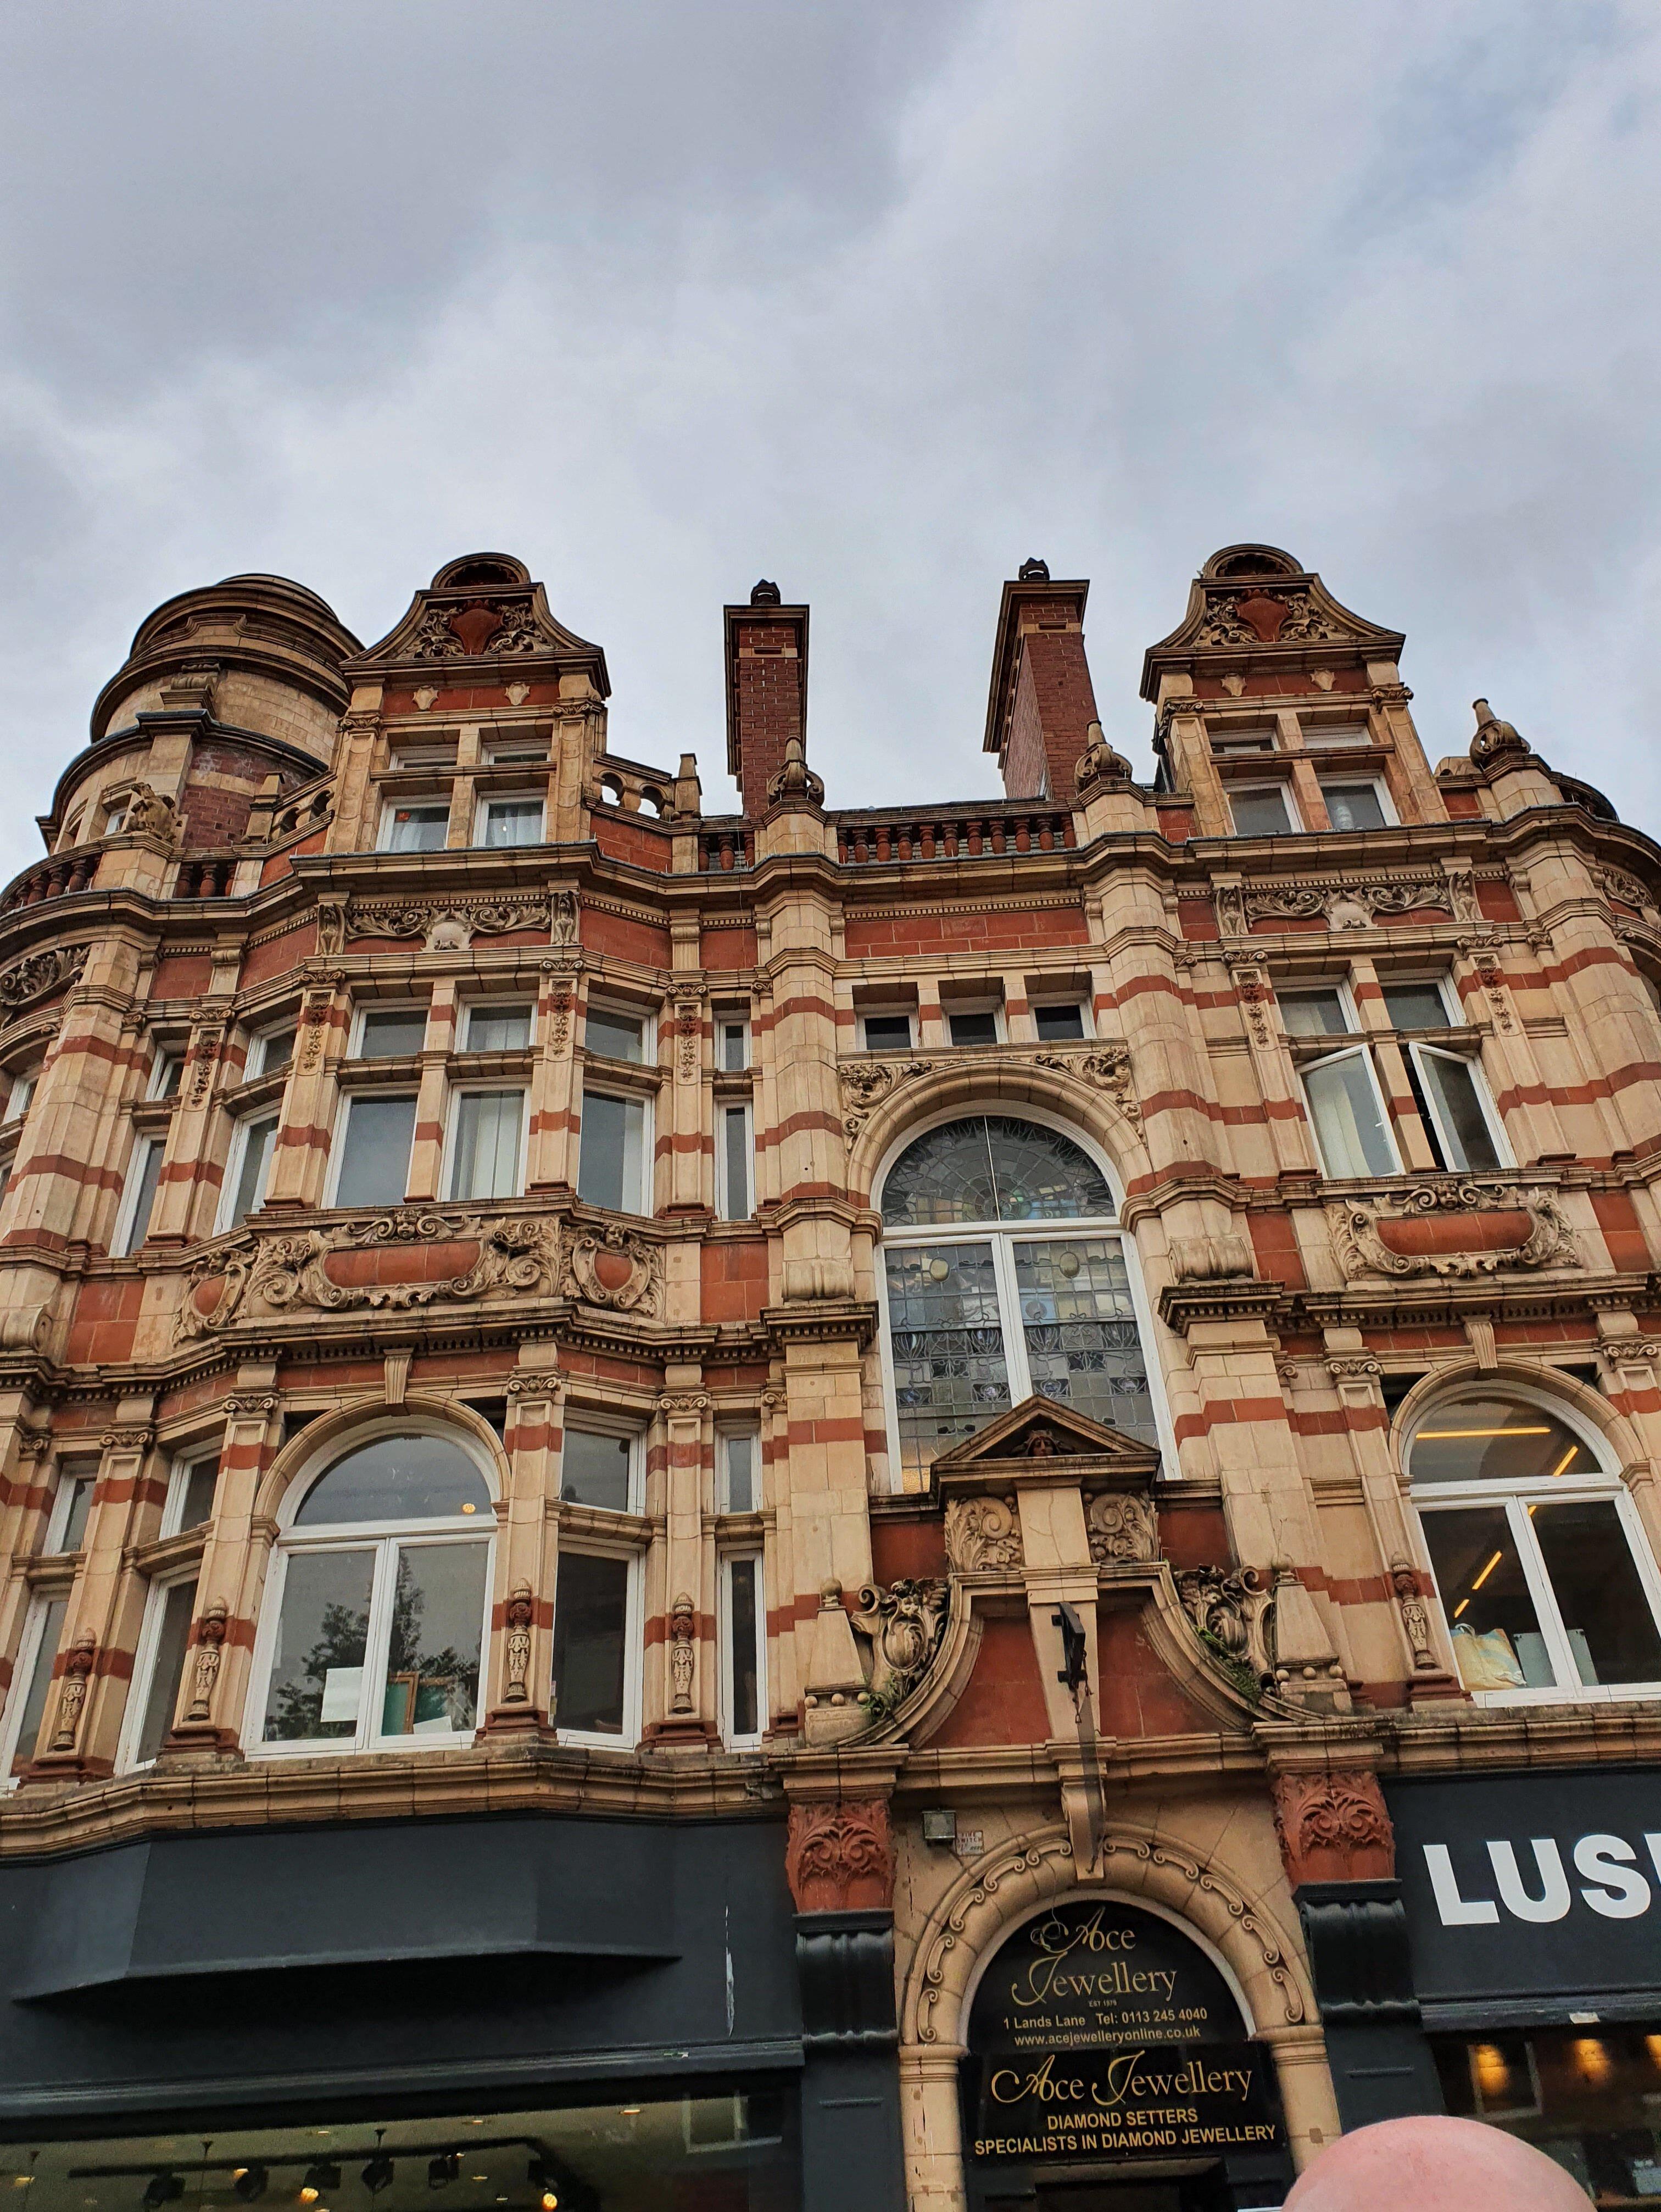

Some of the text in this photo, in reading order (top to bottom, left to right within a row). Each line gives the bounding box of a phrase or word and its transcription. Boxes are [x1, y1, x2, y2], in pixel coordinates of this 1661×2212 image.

[1423, 1833, 1661, 1925] LUS
[1041, 1906, 1136, 1953] Ace
[1011, 1951, 1177, 2006] Jewellery
[1004, 2007, 1207, 2030] 1 Lands Lane Tel: 0113 245 4040
[1015, 2025, 1201, 2046] www.acejewelleryonline.co.uk
[991, 2050, 1252, 2106] Ace Jewellery
[1047, 2108, 1198, 2130] DIAMOND SETTERS
[975, 2124, 1275, 2155] SPECIALISTS IN DIAMOND JEWELLERY
